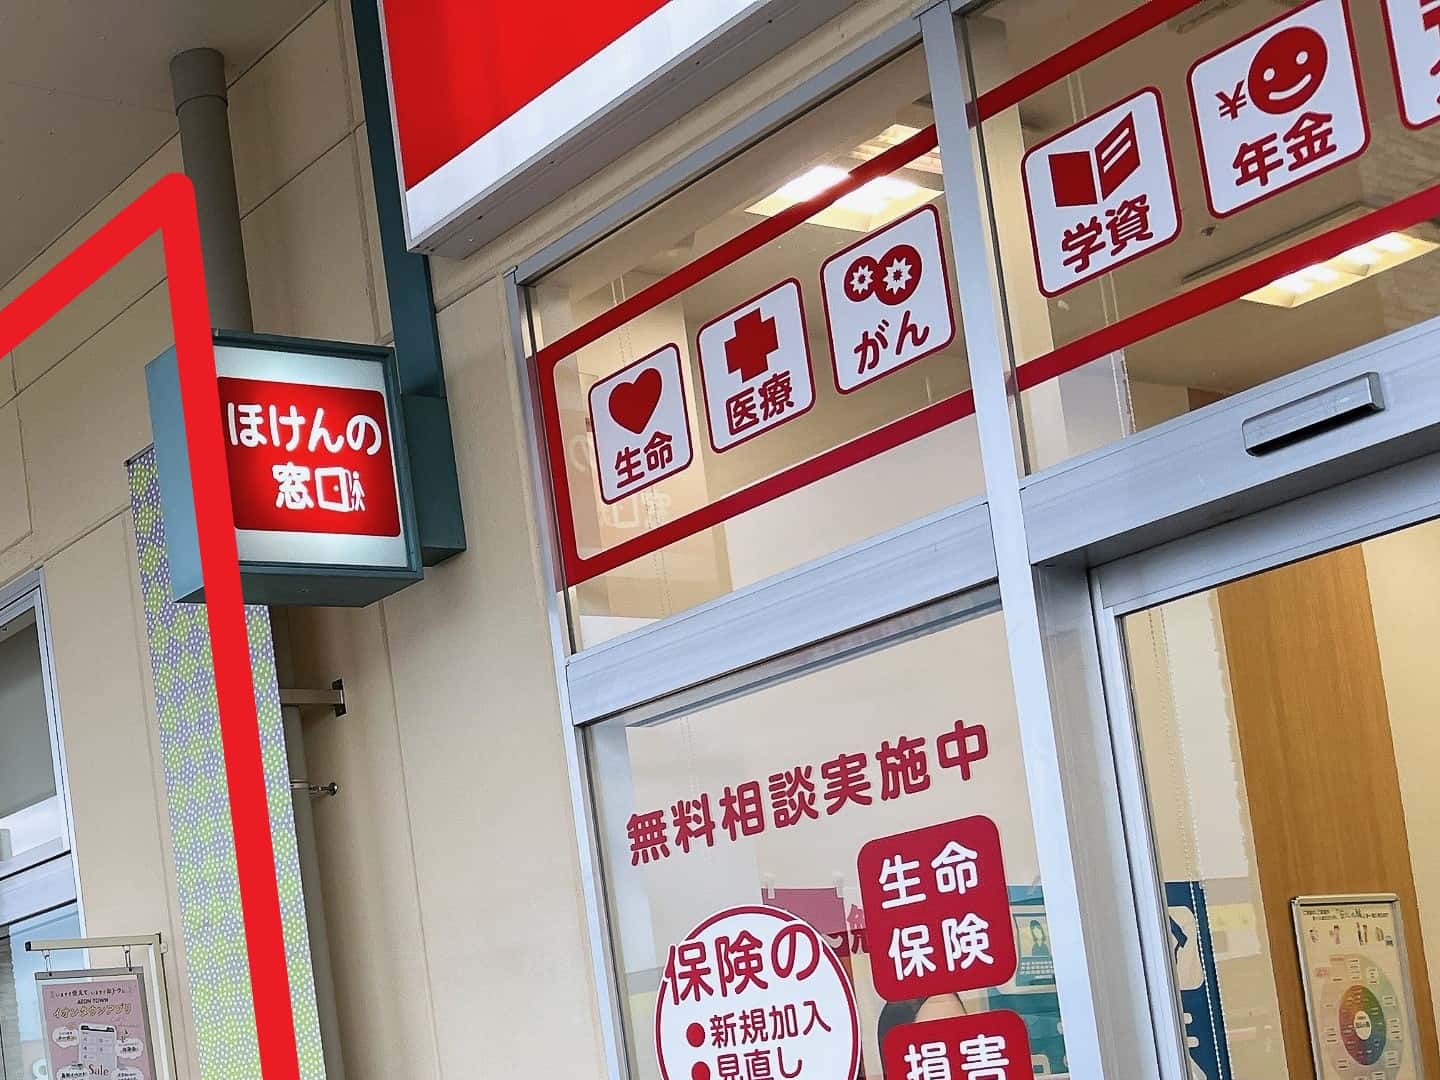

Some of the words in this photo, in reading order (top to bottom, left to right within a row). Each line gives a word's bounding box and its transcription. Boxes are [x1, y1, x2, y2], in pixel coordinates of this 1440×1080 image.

[1232, 112, 1338, 187] 年金
[1061, 194, 1154, 274] 学資
[854, 310, 930, 374] がん
[227, 402, 382, 456] ほけんの
[725, 370, 795, 436] 医療
[271, 461, 352, 513] 窓口
[615, 431, 672, 489] 生命
[626, 719, 989, 867] 無料相談実施中
[878, 840, 979, 910] 生命
[664, 923, 821, 1006] 保険の
[888, 912, 994, 981] 保険
[709, 1000, 832, 1048] 新規加入
[88, 1063, 110, 1077] Sale
